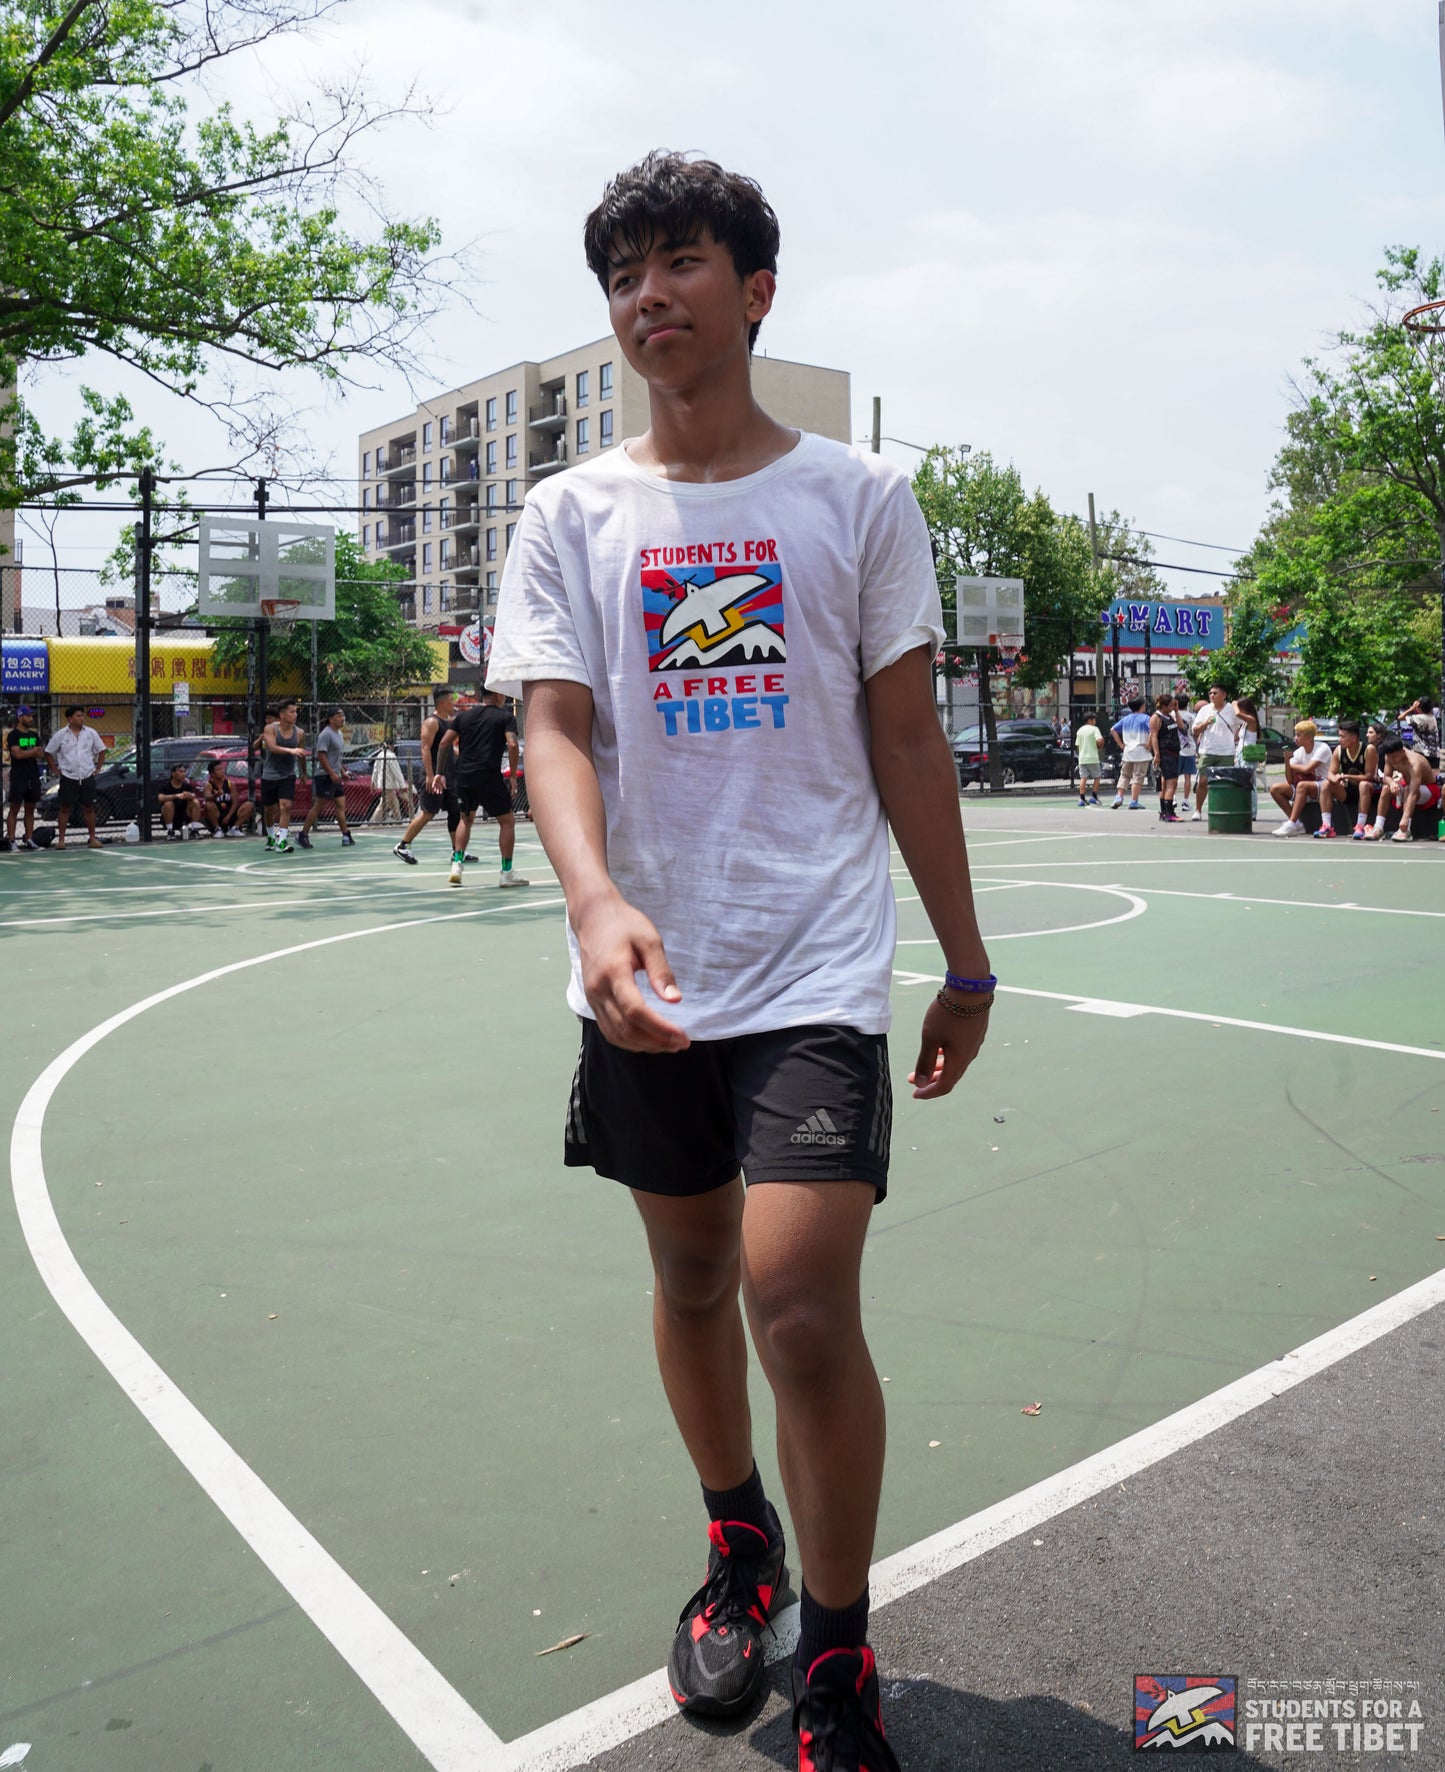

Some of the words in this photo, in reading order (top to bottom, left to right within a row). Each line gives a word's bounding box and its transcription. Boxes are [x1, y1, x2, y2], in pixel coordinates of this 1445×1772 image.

[640, 541, 737, 568] STUDENTS
[744, 539, 779, 562] FOR
[1129, 604, 1212, 636] MART
[653, 681, 673, 700] A
[683, 674, 785, 697] FREE
[656, 695, 790, 736] TIBET
[790, 1130, 846, 1145] adidas
